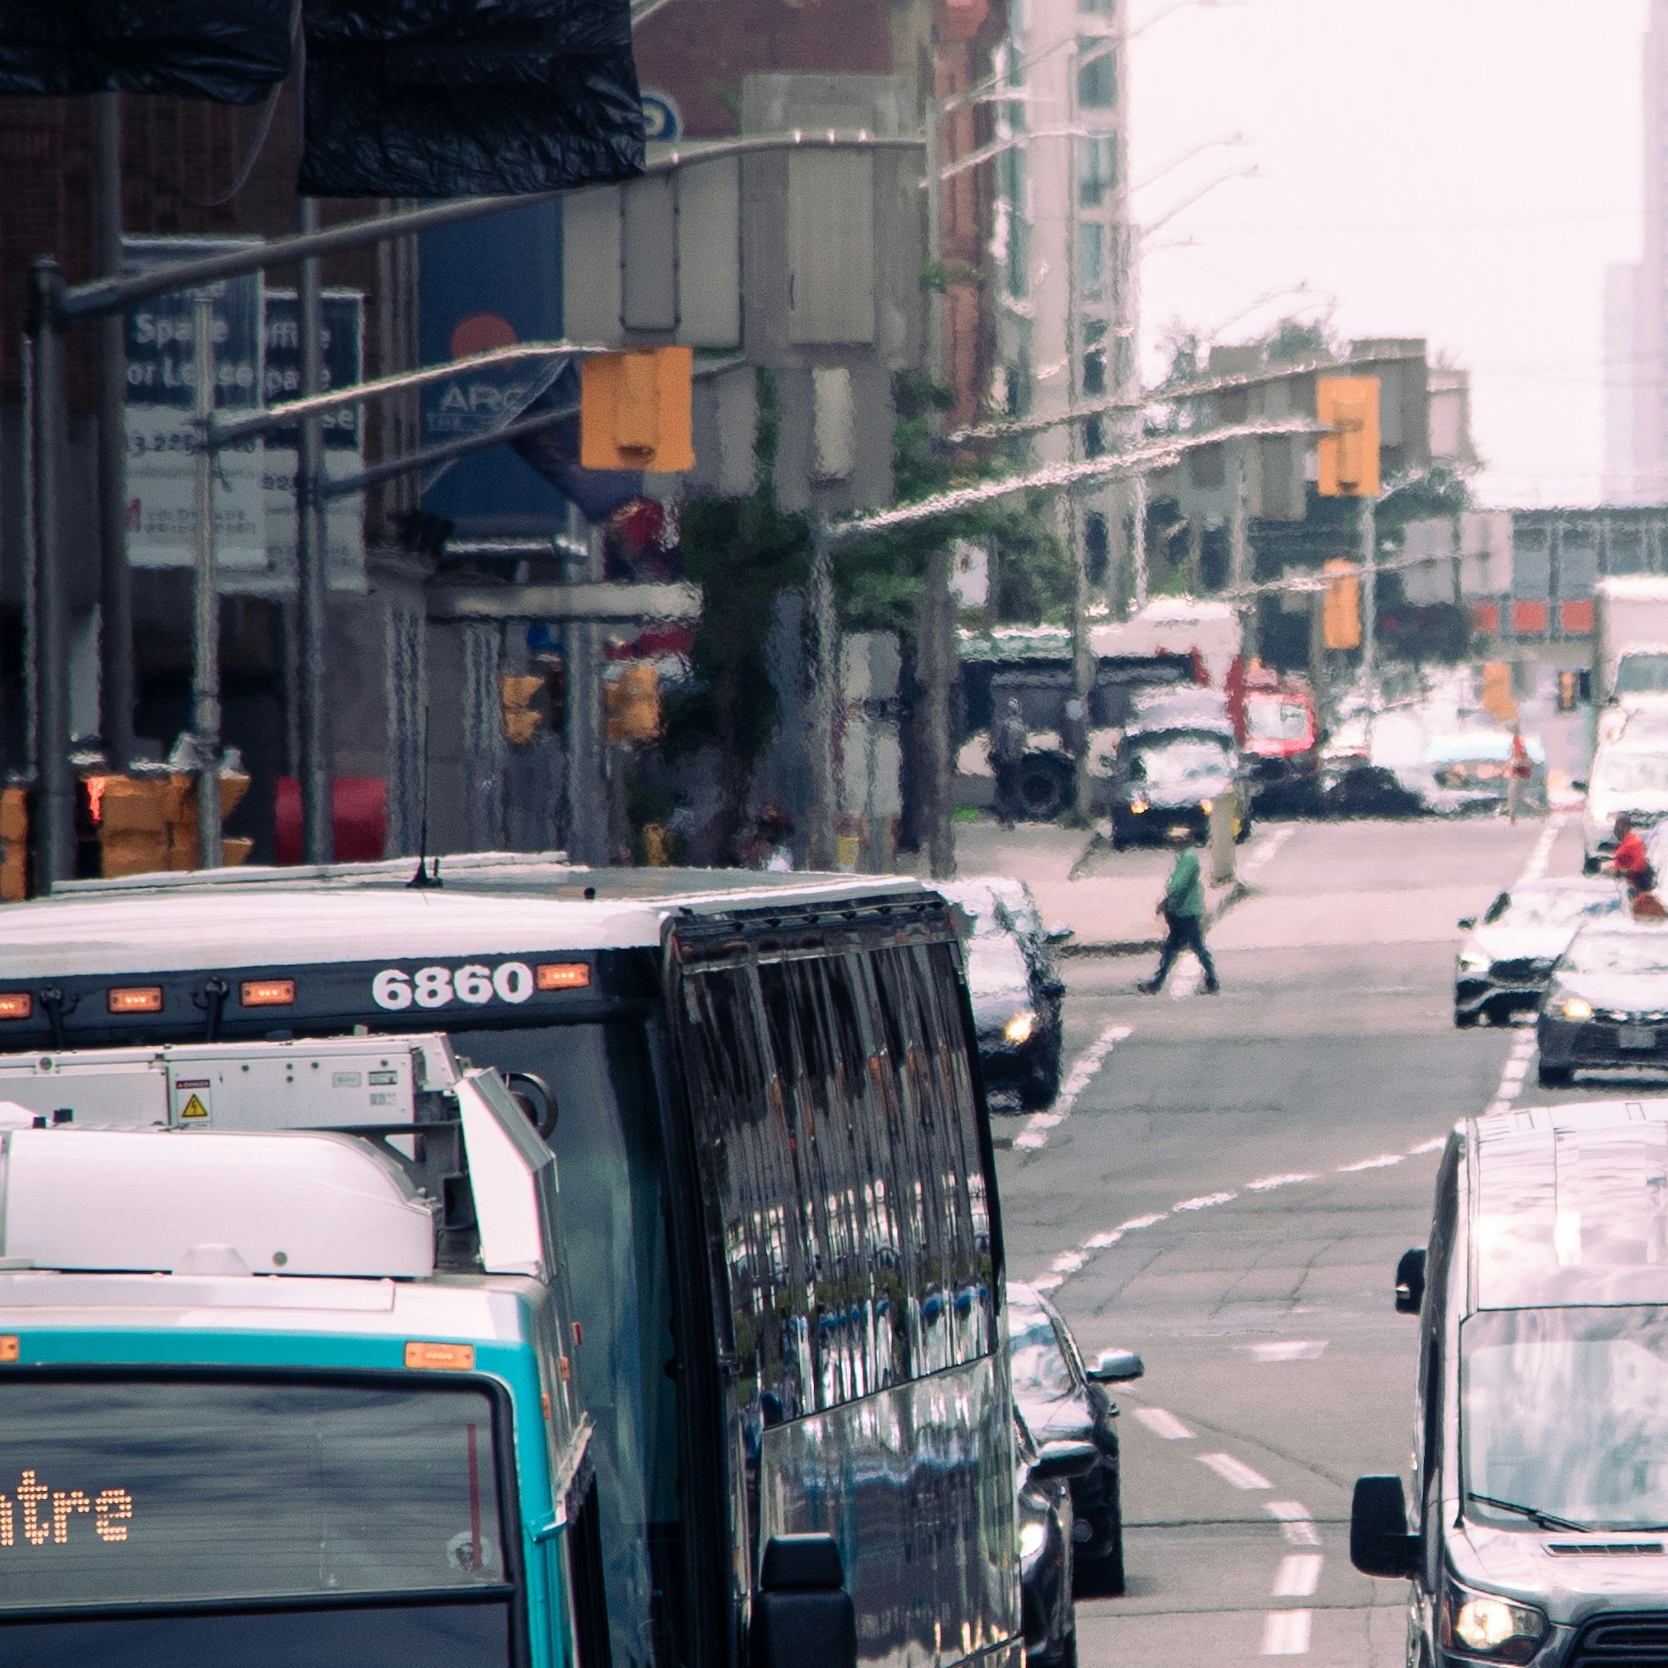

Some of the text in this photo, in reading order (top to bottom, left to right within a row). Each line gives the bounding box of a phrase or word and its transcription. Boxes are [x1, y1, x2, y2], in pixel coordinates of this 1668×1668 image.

[135, 313, 228, 349] Spae
[163, 356, 254, 388] Lese
[371, 961, 534, 1011] 6860
